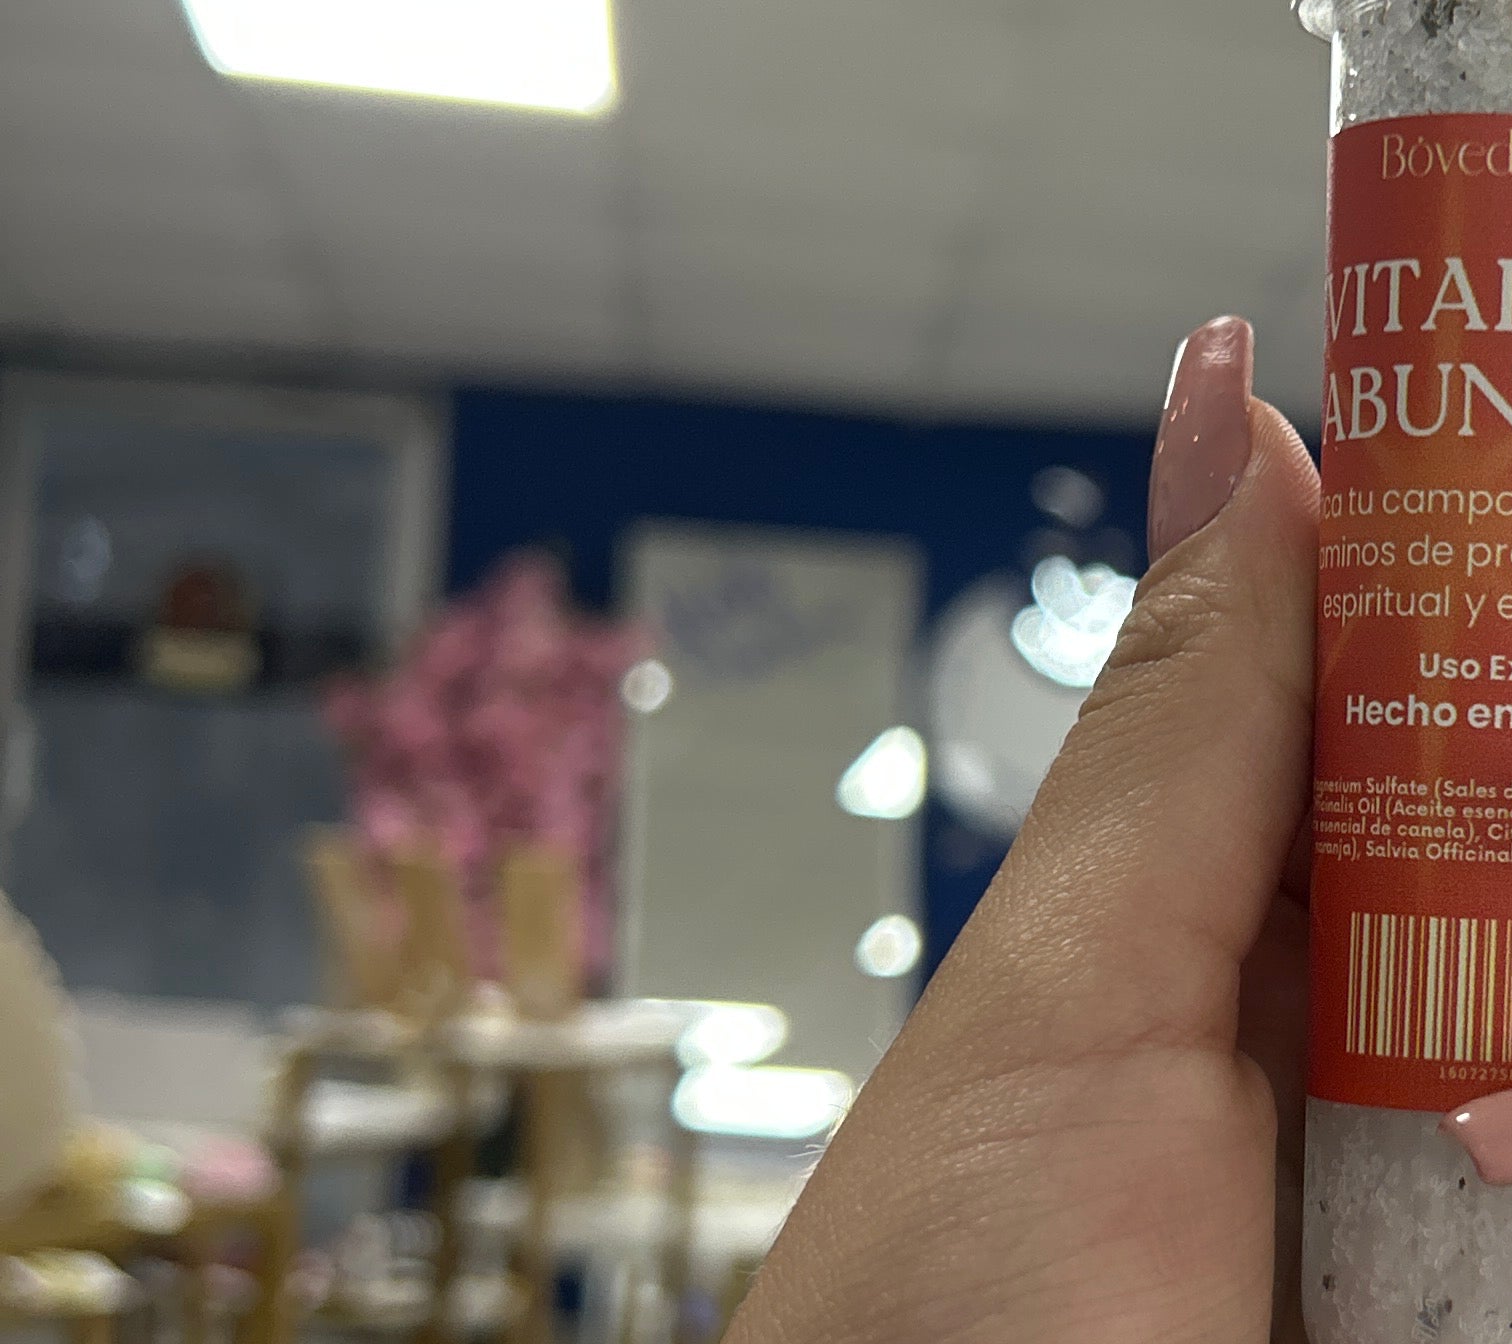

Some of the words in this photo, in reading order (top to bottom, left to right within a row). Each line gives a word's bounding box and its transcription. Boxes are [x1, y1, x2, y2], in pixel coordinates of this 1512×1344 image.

[1348, 487, 1374, 516] tu
[1407, 535, 1453, 567] de
[1323, 584, 1450, 628] espiritual
[1464, 593, 1487, 629] y
[1419, 652, 1481, 681] Uso
[1345, 694, 1457, 727] Hecho
[1366, 775, 1429, 796] Sulfate
[1357, 795, 1381, 815] Oil
[1370, 816, 1392, 837] de
[1366, 838, 1420, 860] Salvia
